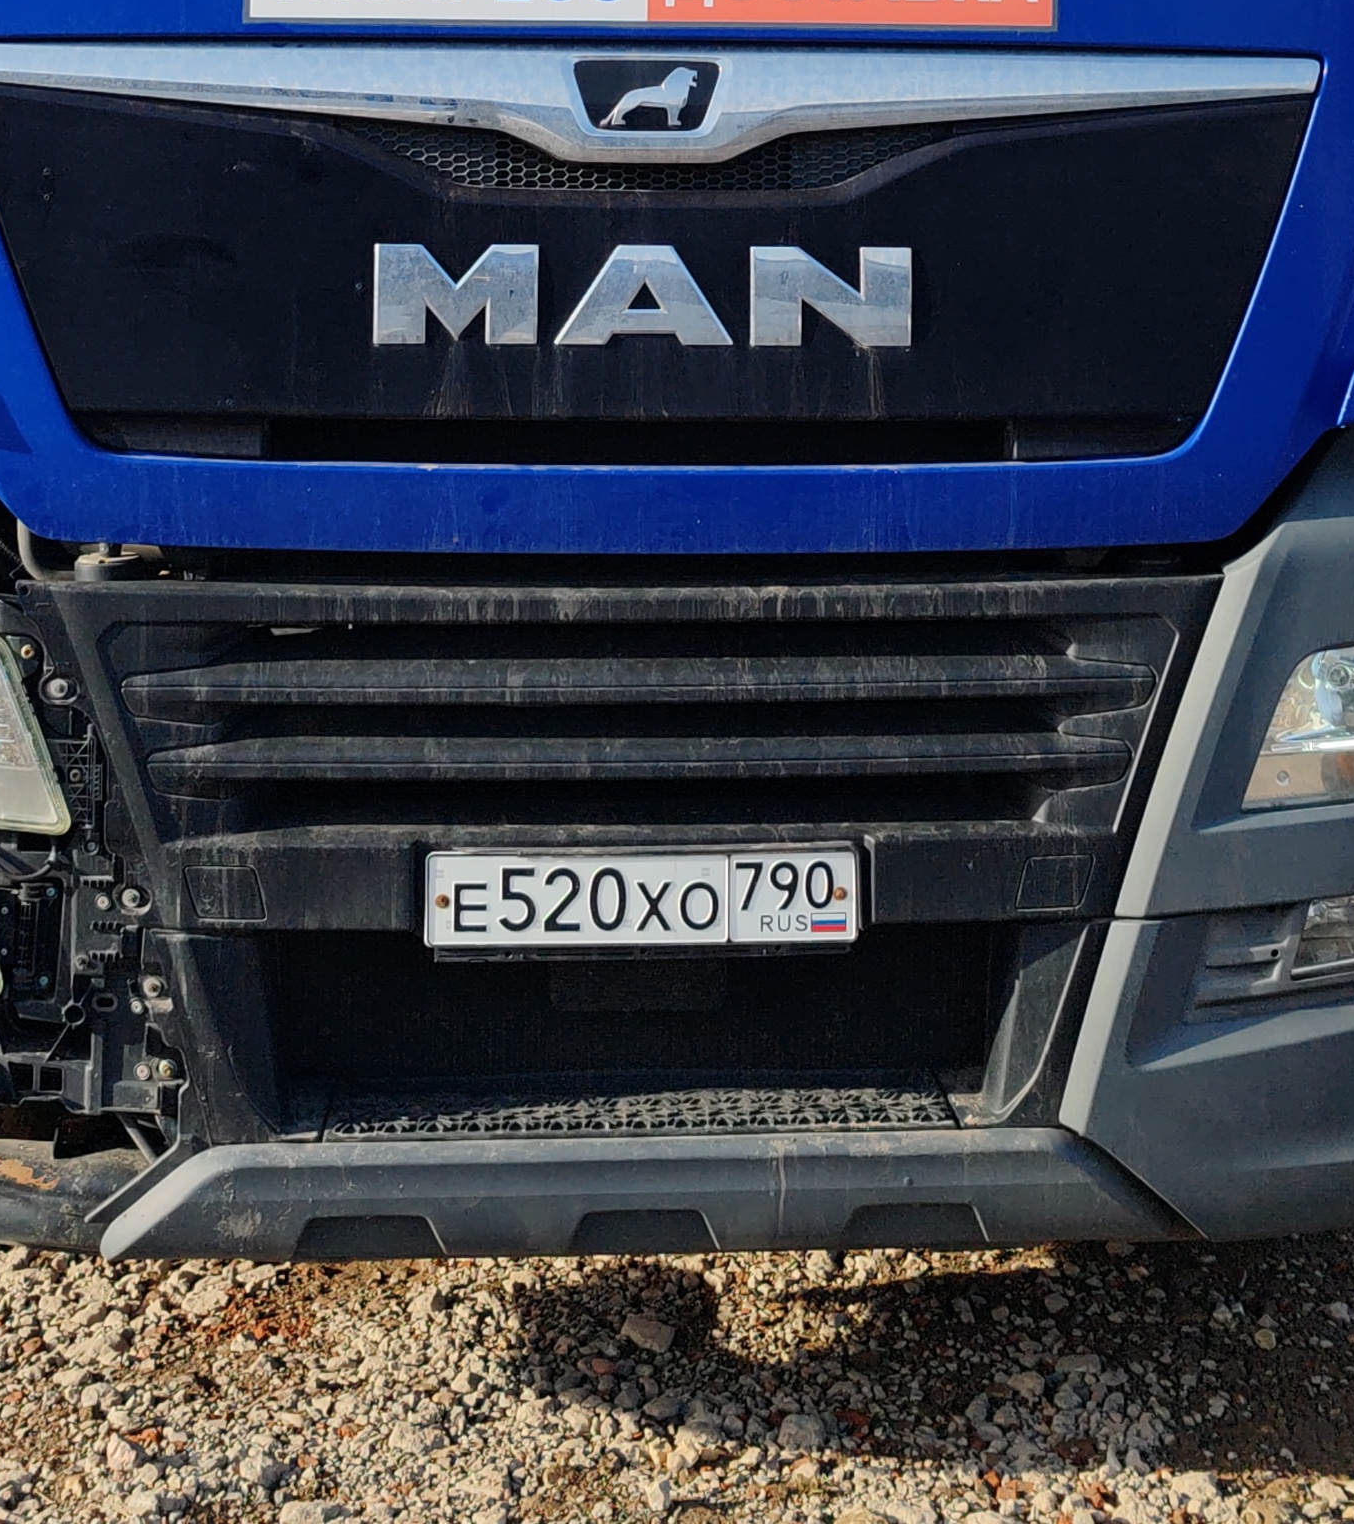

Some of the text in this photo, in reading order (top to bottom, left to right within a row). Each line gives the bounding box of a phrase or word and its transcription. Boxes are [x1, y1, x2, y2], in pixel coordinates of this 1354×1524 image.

[371, 242, 914, 348] MAN
[734, 860, 835, 912] 790
[759, 913, 809, 933] RUS
